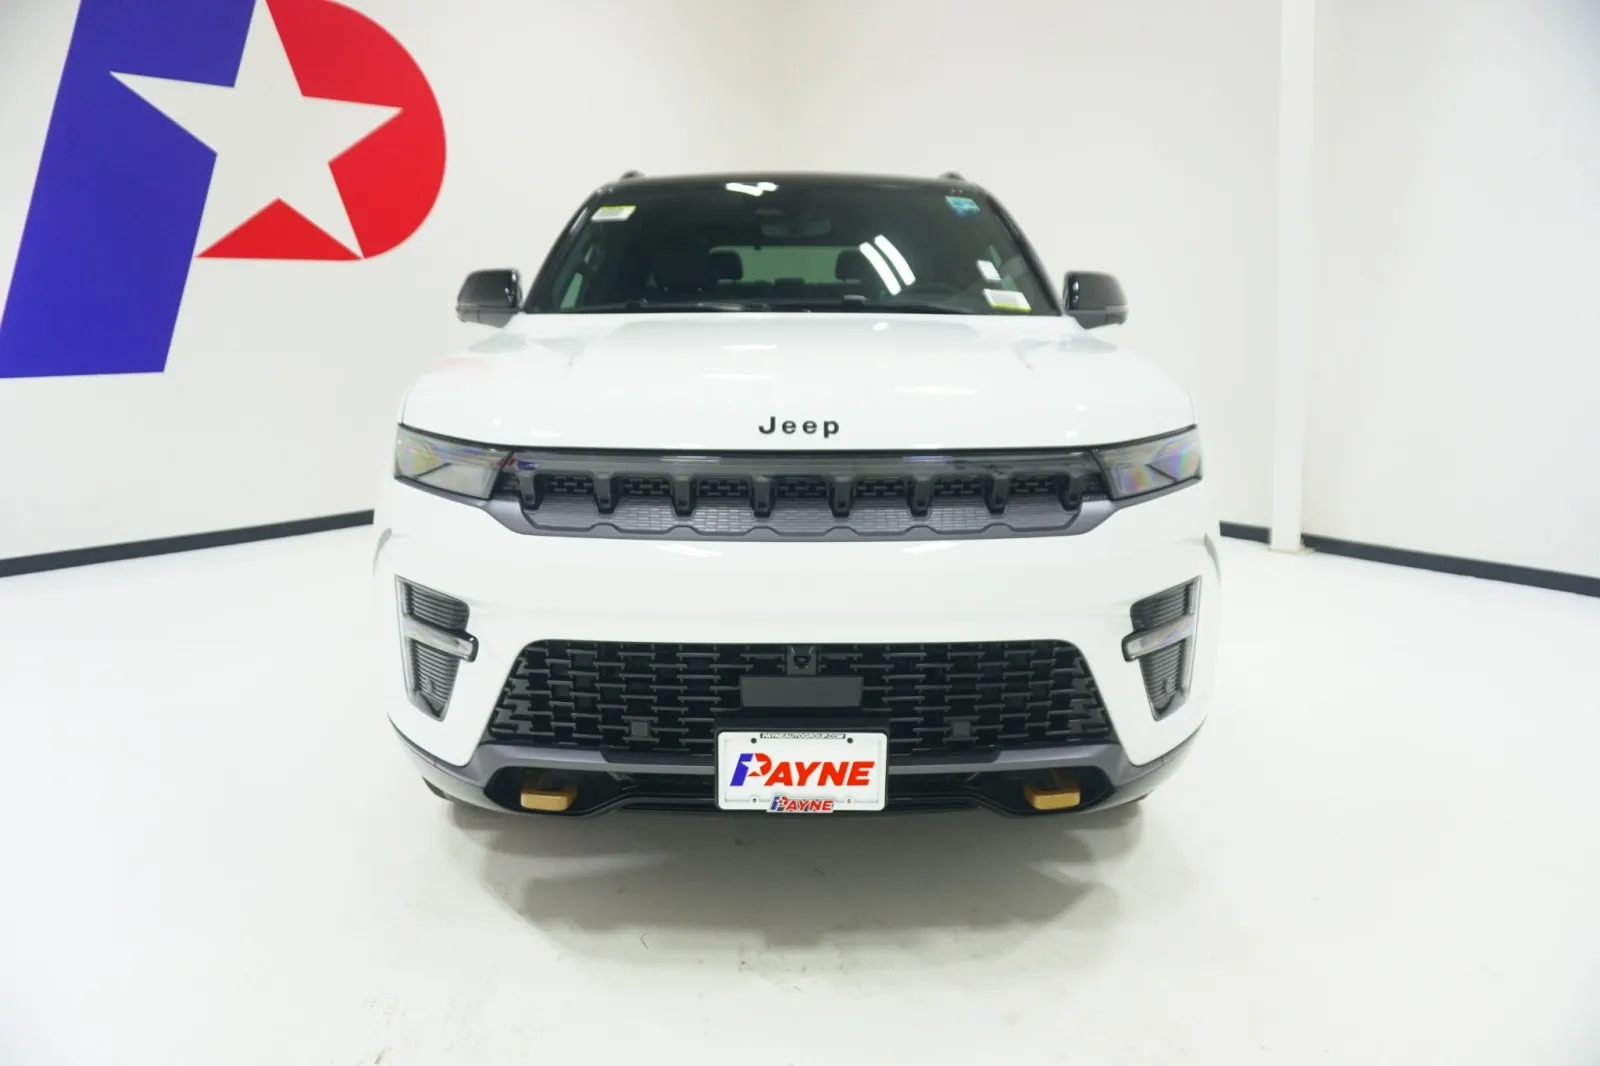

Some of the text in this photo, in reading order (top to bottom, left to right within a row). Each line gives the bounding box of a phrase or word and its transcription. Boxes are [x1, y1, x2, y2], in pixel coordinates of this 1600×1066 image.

[758, 416, 839, 438] Jeep
[730, 753, 875, 786] PAYNE
[770, 796, 834, 811] PAYNE
